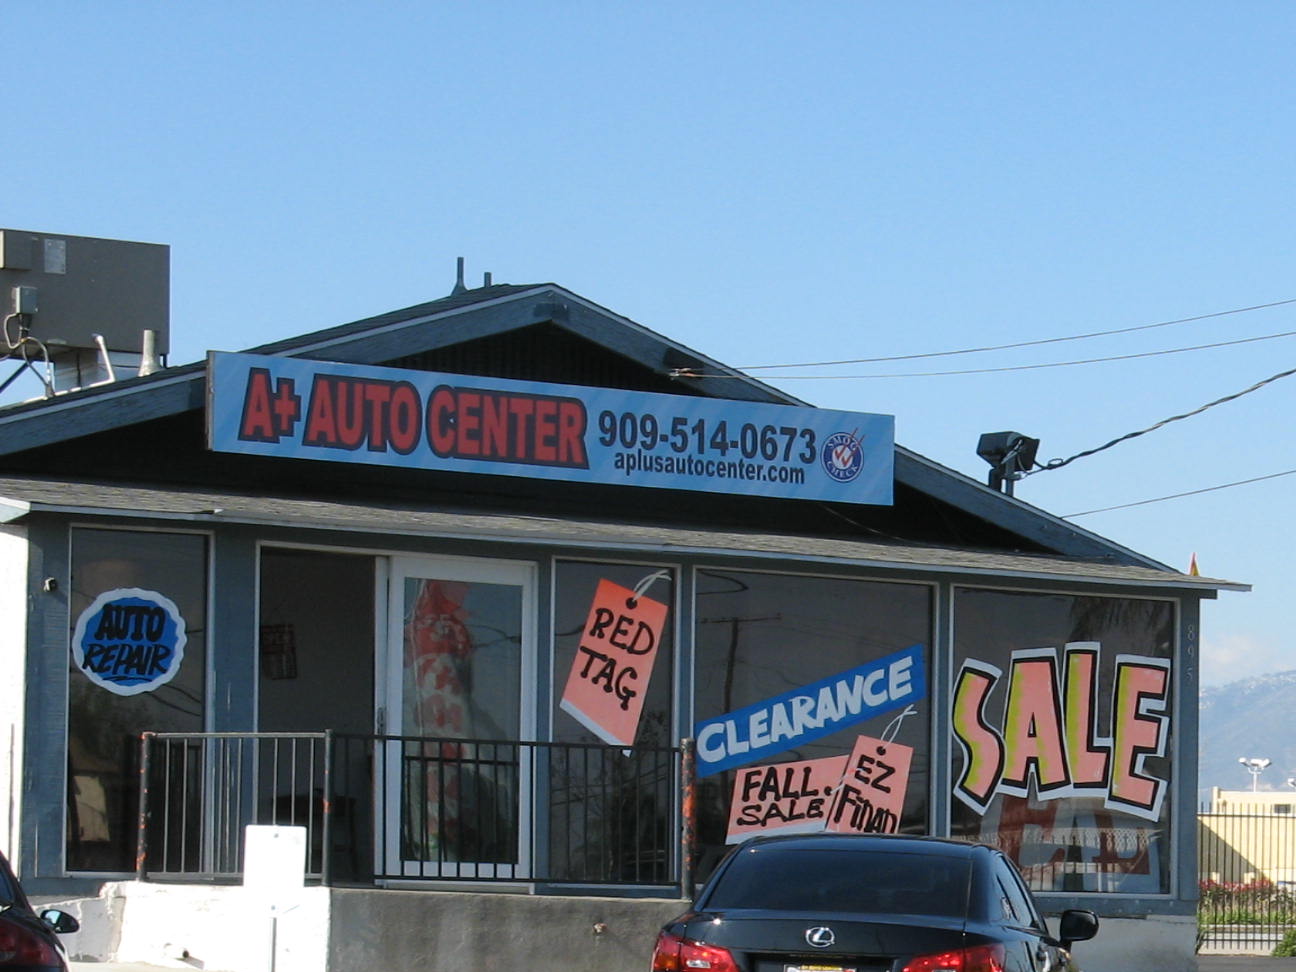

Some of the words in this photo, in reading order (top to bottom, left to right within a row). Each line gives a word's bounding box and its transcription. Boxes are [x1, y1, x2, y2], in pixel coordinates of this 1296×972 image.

[240, 369, 299, 441] A+
[304, 375, 421, 454] AUTO
[427, 386, 588, 469] CENTER
[598, 410, 817, 464] 909-514-0673
[614, 449, 805, 485] aplusautocenter.com
[94, 604, 166, 642] AUTO
[590, 608, 655, 655] RED
[82, 643, 171, 675] REPAIR
[580, 646, 637, 711] TAG
[697, 656, 913, 763] CLEARANCE
[953, 646, 1169, 814] SALE
[742, 766, 819, 802] FALL
[855, 755, 896, 794] EZ
[737, 798, 825, 827] SALE
